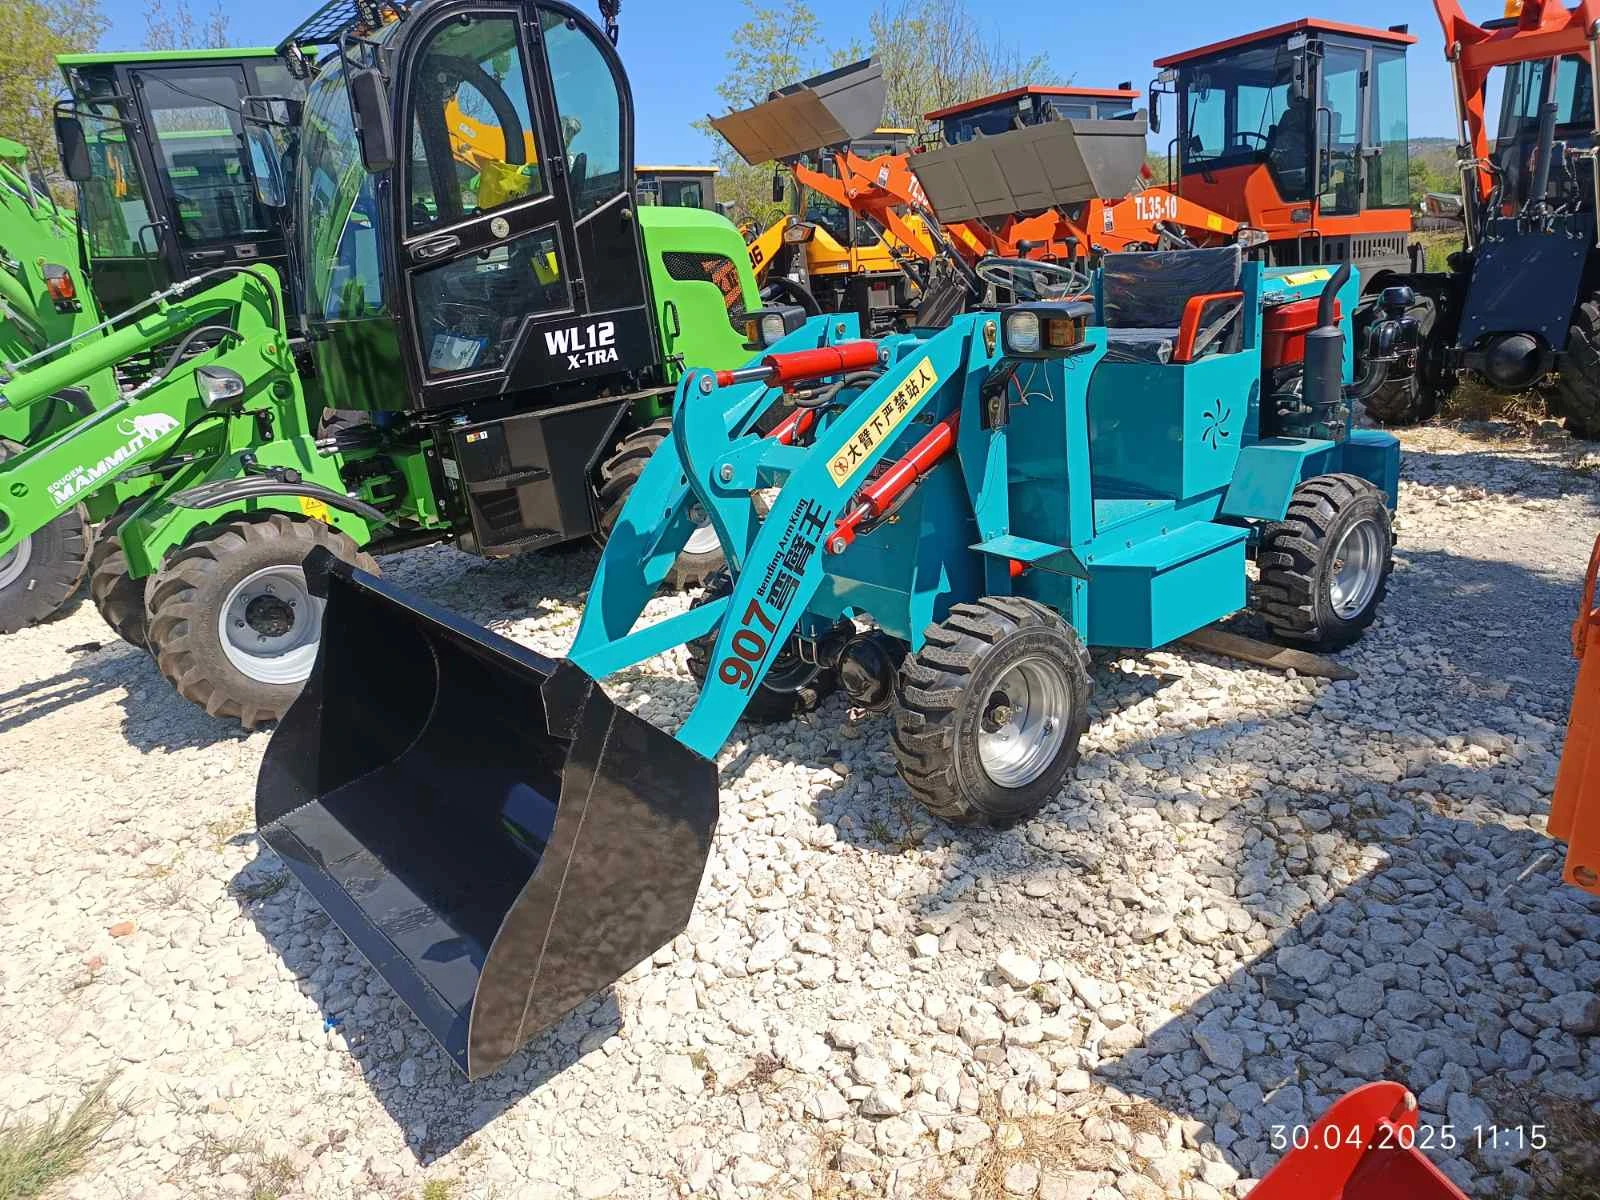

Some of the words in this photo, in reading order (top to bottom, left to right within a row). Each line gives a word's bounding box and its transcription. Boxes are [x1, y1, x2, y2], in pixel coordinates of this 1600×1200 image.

[1135, 196, 1177, 220] TL35-10
[544, 321, 616, 356] WL12
[567, 347, 619, 371] X-TRA
[847, 369, 931, 465] 大臂下严禁站人
[756, 552, 785, 597] Bending
[718, 597, 777, 691] 907
